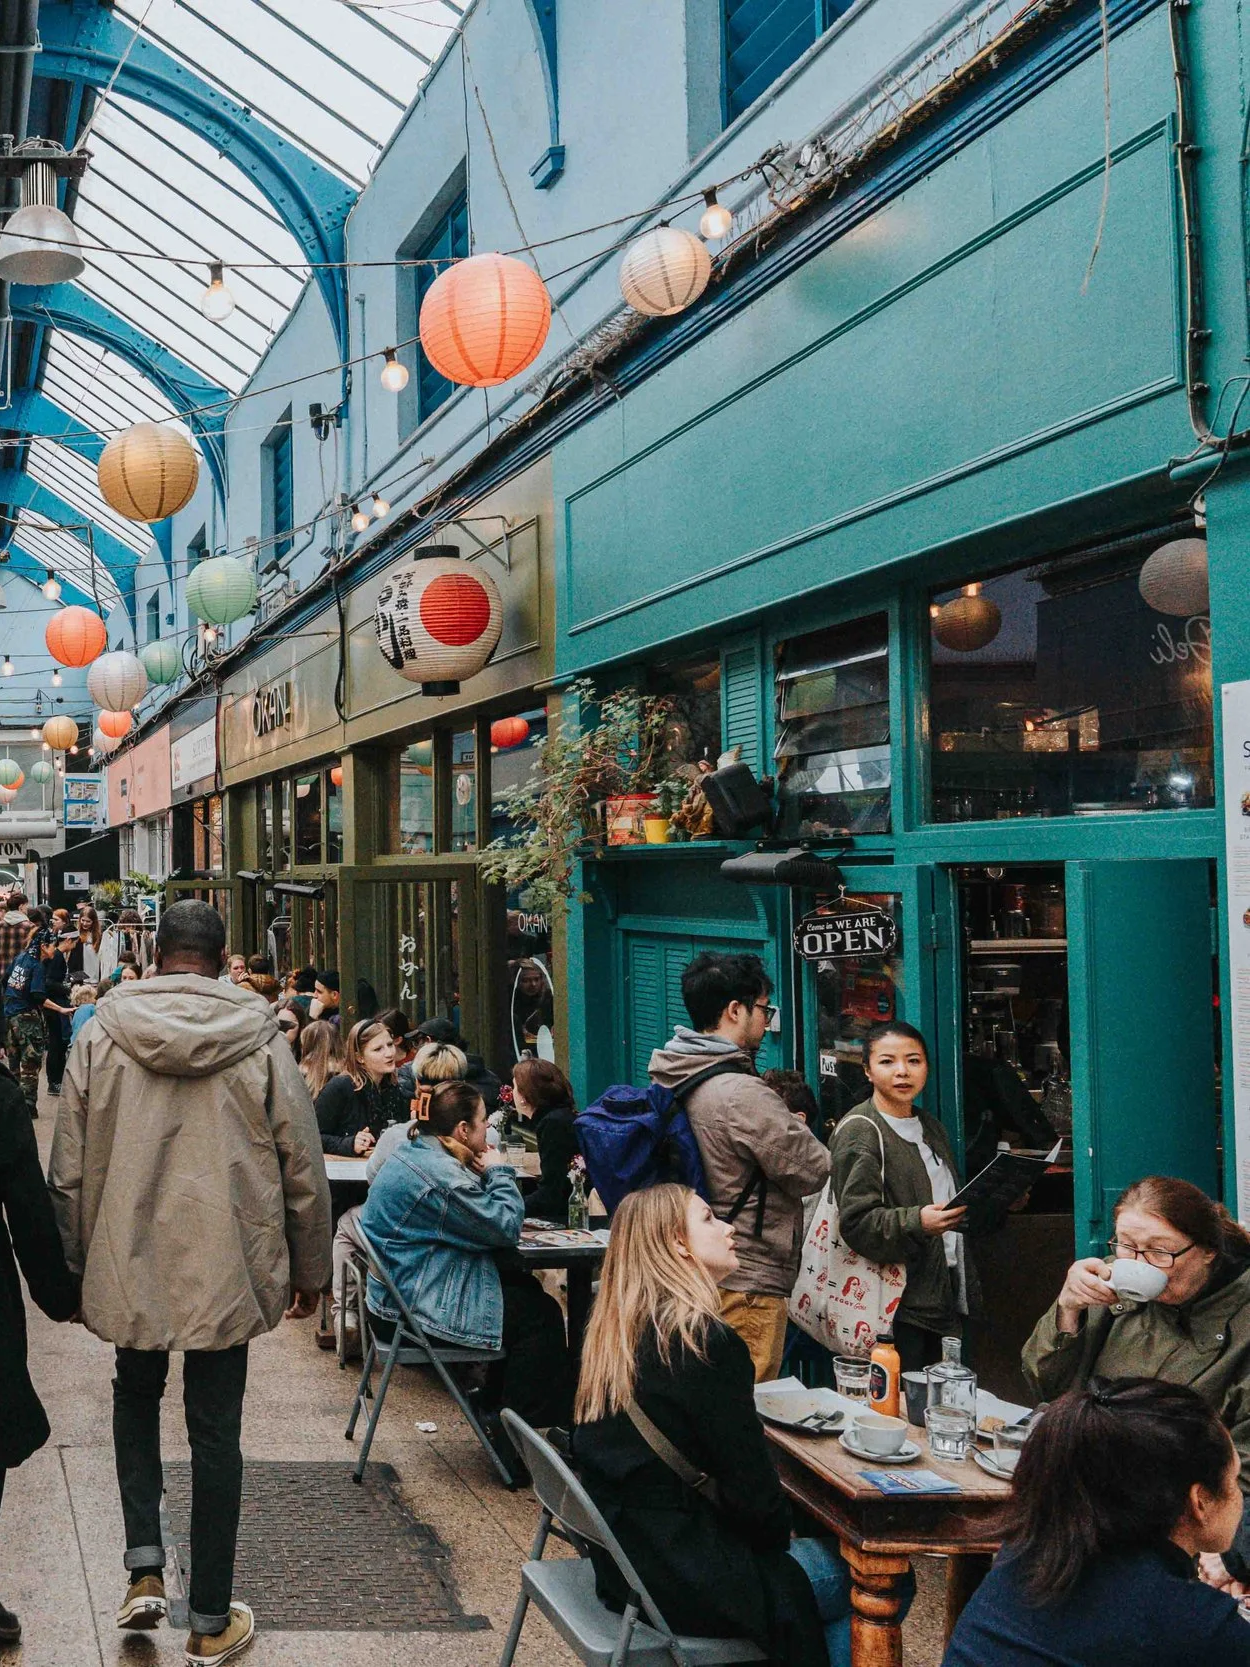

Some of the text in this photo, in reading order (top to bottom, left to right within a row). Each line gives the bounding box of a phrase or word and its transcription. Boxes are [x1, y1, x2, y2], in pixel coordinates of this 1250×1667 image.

[517, 912, 548, 934] OKAN
[807, 916, 877, 932] Come in WE ARE
[802, 926, 885, 955] OPEN
[829, 1294, 853, 1308] PEGGY
